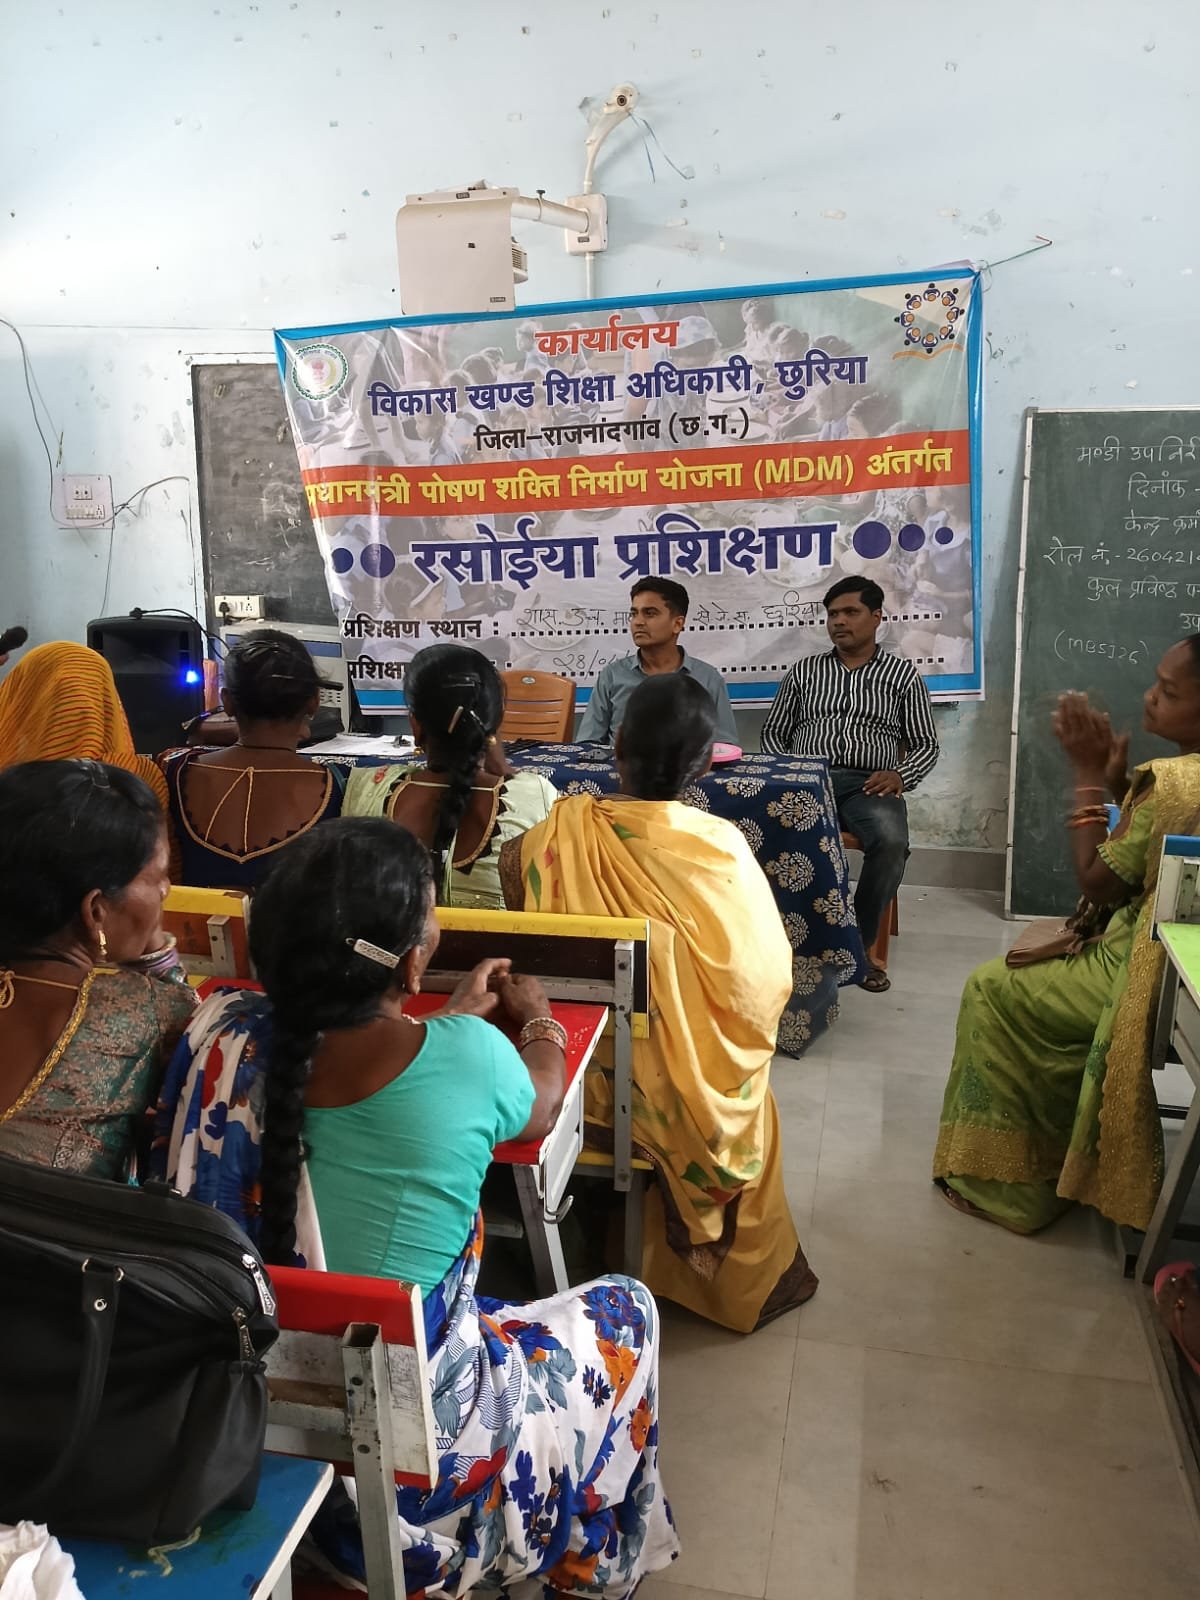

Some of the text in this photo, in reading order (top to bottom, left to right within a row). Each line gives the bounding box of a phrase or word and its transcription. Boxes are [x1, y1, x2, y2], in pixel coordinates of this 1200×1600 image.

[534, 314, 680, 356] कार्यालय
[368, 348, 869, 417] विकास खण्ड शिक्षा अधिकारी, छुरिया
[668, 407, 750, 443] (छ.ग.)
[418, 472, 486, 504] पोषण
[492, 467, 561, 501] शक्ति
[567, 460, 648, 497] निर्माण
[656, 457, 743, 491] योजना
[753, 454, 855, 491] (MDM)
[866, 438, 953, 476] अंतर्गत
[1127, 470, 1189, 501] दिनांक
[410, 511, 839, 590] रसोईया प्रशिक्षण
[1042, 535, 1085, 567] रोल
[1087, 576, 1123, 601] कुल
[343, 613, 421, 639] प्रशिक्षण
[427, 619, 483, 639] स्थान
